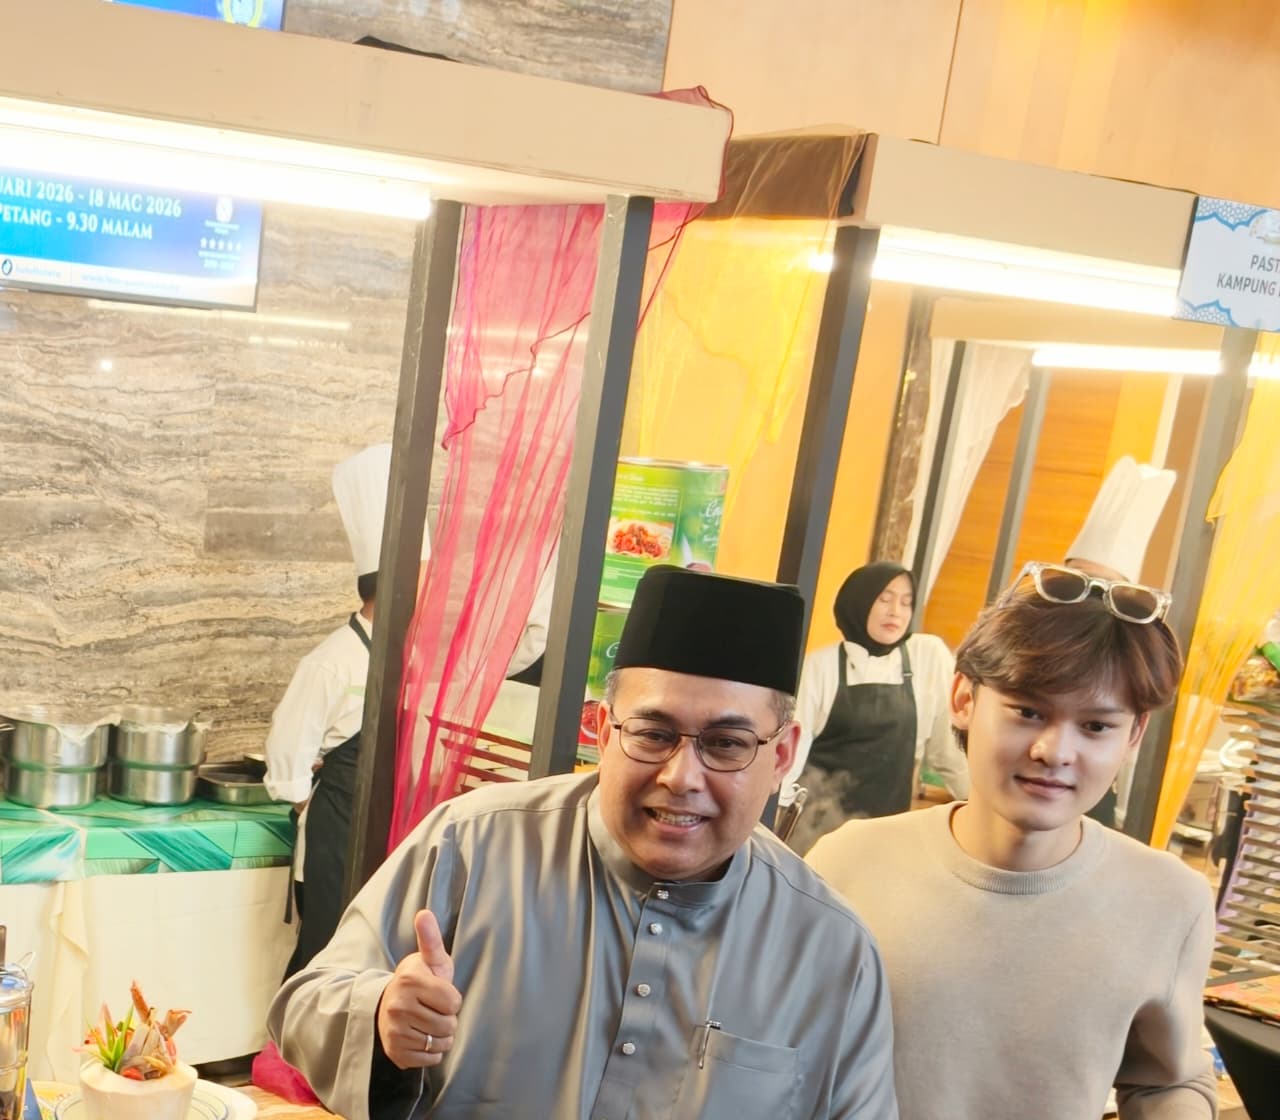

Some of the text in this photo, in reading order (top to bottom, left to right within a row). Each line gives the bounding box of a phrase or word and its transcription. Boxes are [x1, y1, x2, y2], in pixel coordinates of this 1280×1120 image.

[36, 181, 74, 203] 2026
[88, 187, 104, 208] 18
[107, 191, 143, 214] MAC
[146, 195, 182, 218] 2026
[66, 211, 98, 233] 9.30
[1250, 254, 1280, 273] PAST
[1217, 273, 1277, 296] KAMPUNG
